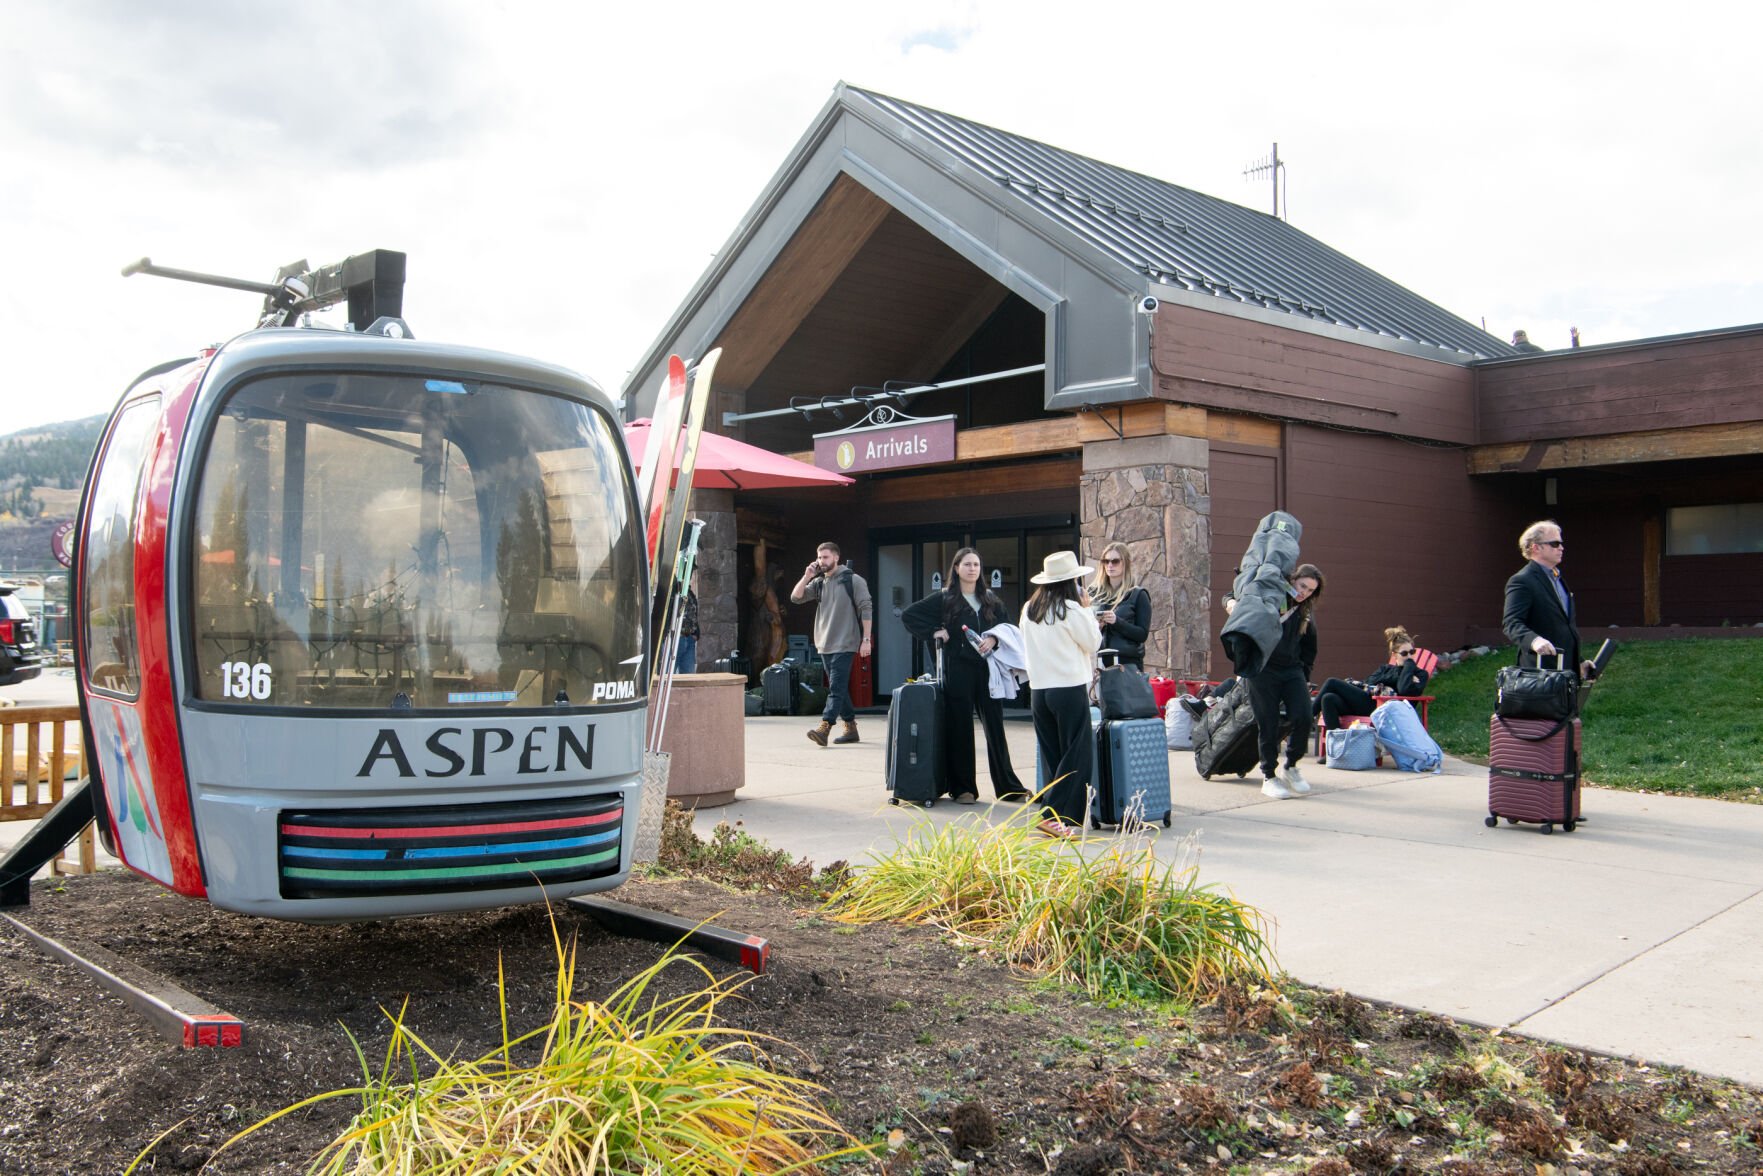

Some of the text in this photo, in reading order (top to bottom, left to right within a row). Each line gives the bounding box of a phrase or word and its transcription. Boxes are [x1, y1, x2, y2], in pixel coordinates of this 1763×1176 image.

[866, 434, 928, 460] Arrivals
[221, 661, 272, 700] 136
[592, 680, 635, 700] POMA
[356, 723, 596, 778] ASPEN
